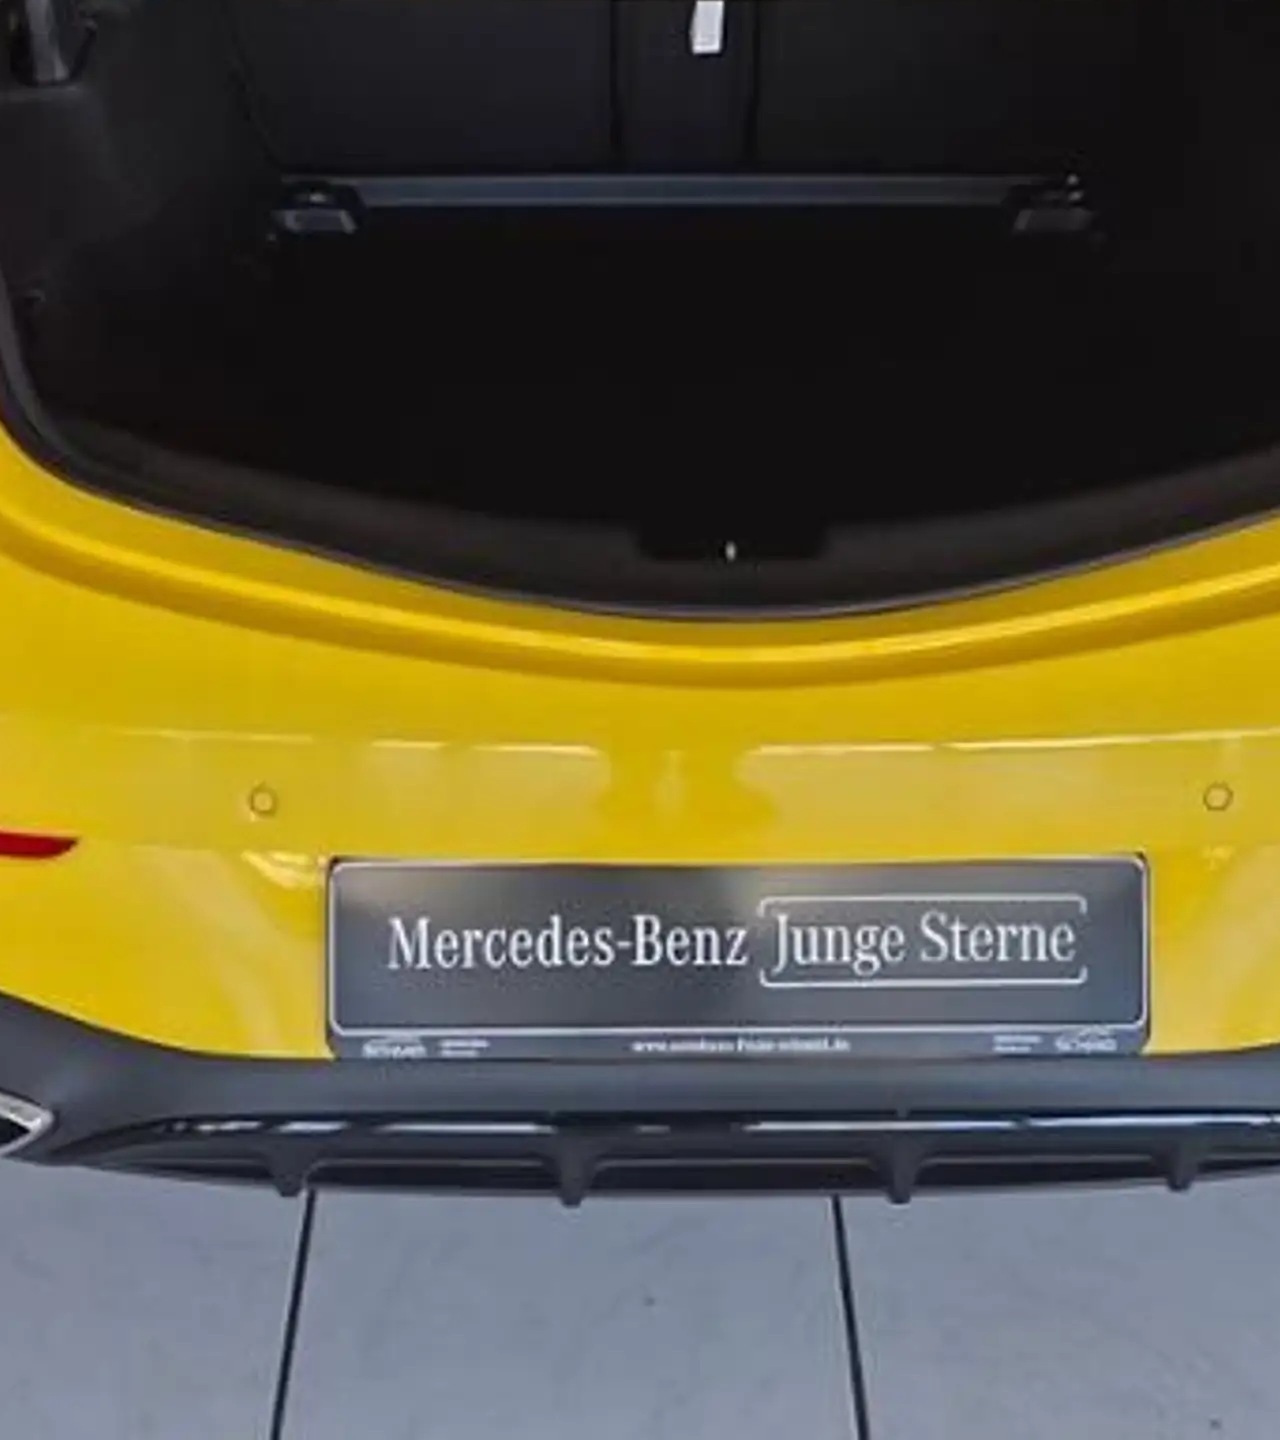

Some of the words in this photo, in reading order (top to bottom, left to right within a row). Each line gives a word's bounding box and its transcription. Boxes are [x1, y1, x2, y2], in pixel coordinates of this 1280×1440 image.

[387, 914, 749, 969] Mercedes-Benz
[771, 913, 906, 977] Junge
[920, 910, 1076, 963] Sterne
